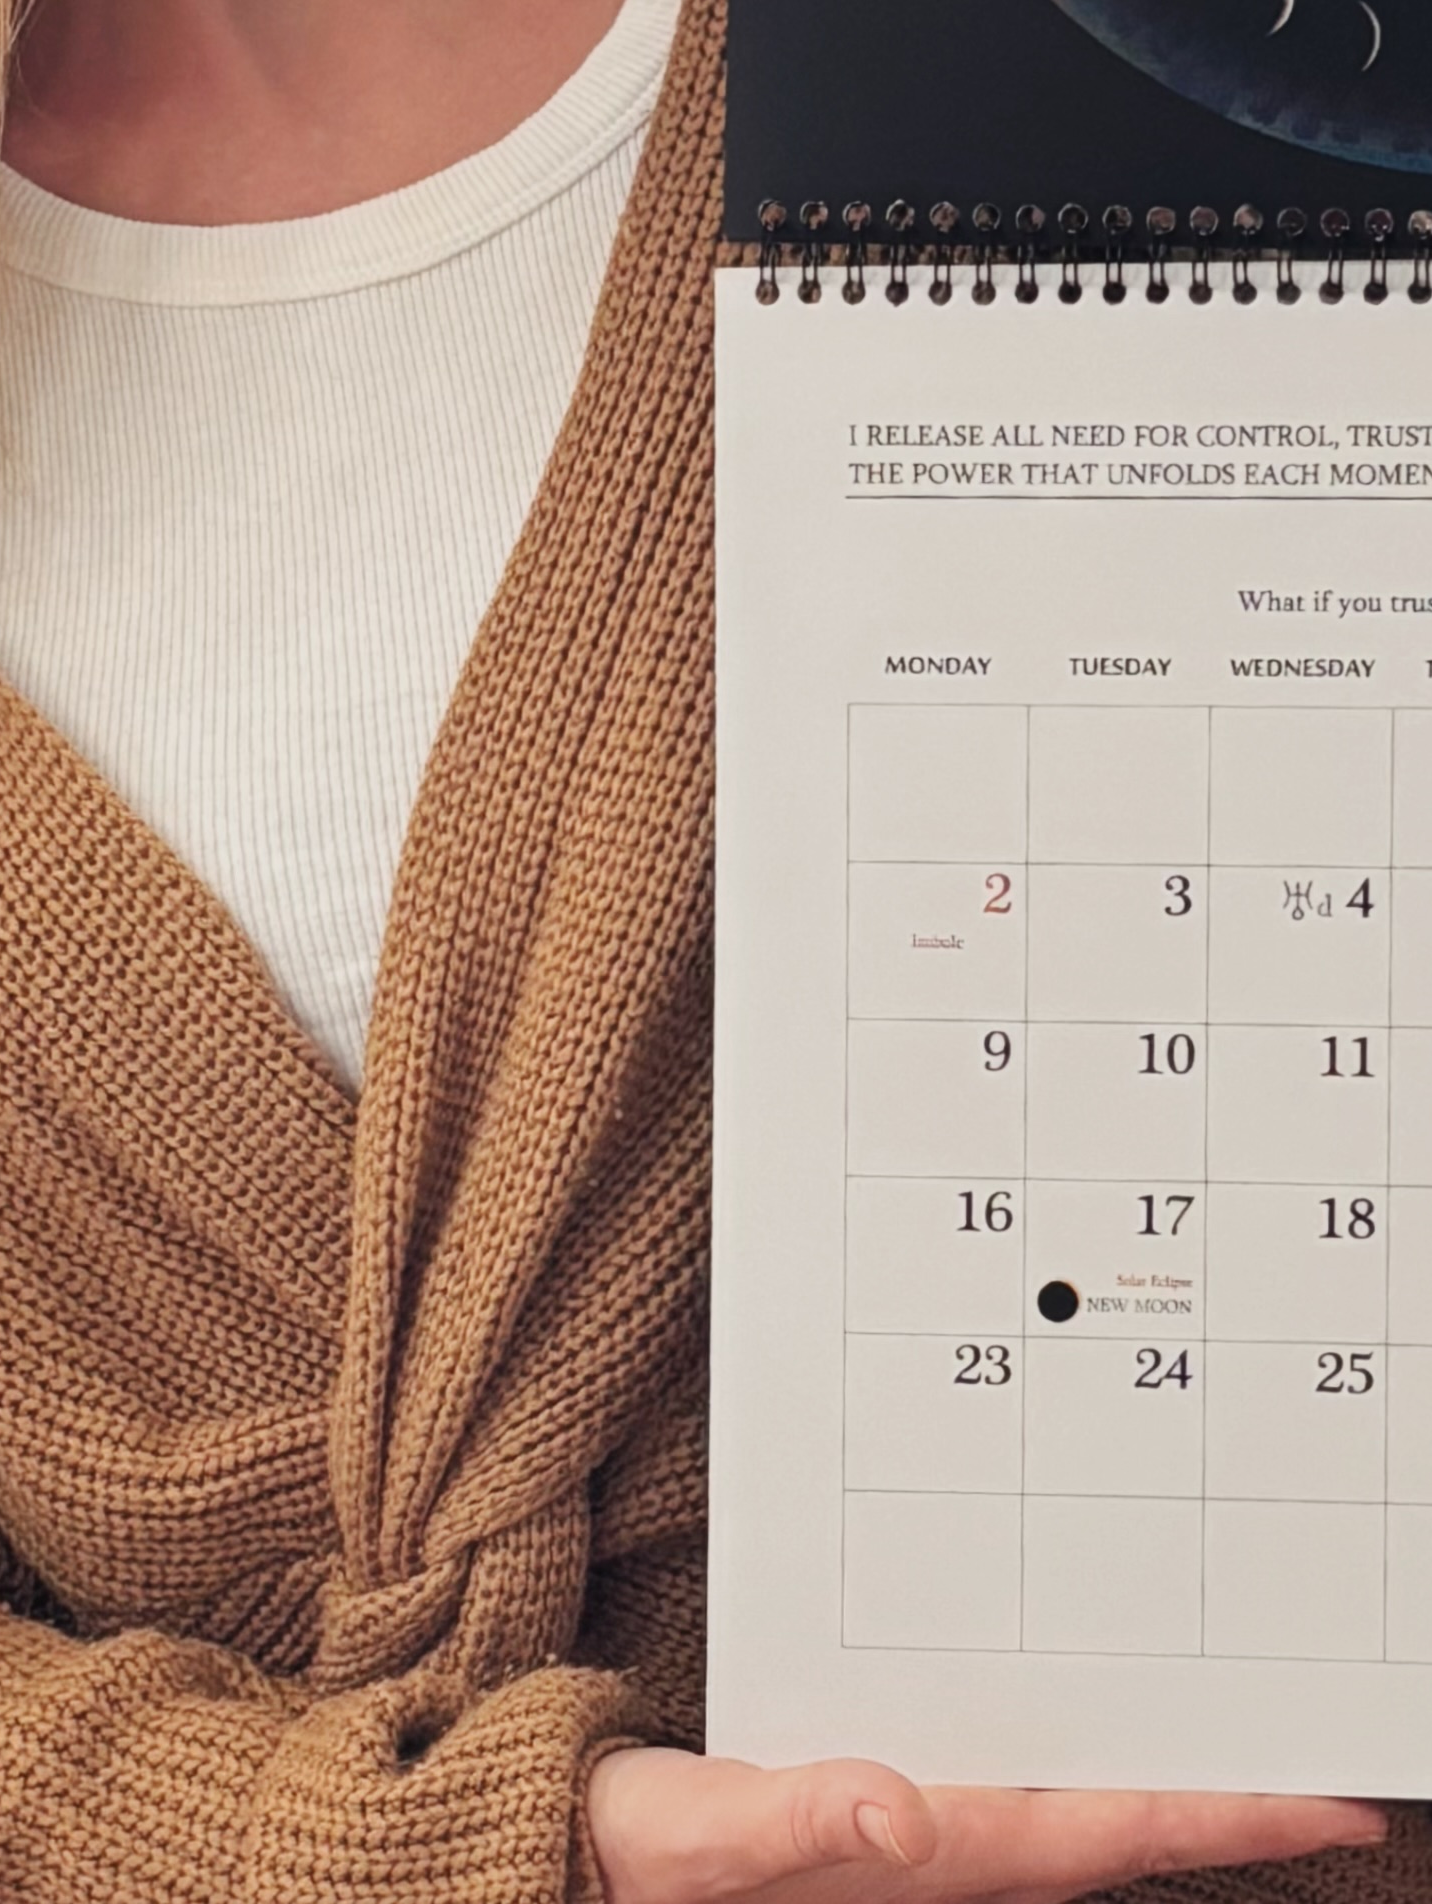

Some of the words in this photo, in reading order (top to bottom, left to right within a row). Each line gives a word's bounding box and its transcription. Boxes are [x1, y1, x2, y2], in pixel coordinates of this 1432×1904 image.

[850, 425, 857, 446] I
[867, 425, 984, 446] RELEASE
[992, 425, 1043, 446] ALL
[1052, 425, 1125, 446] NEED
[1135, 425, 1188, 447] FOR
[1197, 425, 1339, 449] CONTROL,
[849, 463, 903, 484] THE
[913, 463, 1013, 484] POWER
[1021, 463, 1099, 484] THAT
[1108, 463, 1235, 485] UNFOLDS
[1245, 463, 1319, 485] EACH
[1238, 590, 1304, 611] What
[1314, 590, 1333, 612] if
[1339, 597, 1382, 618] you
[885, 656, 991, 675] MONDAY
[1070, 658, 1171, 676] TUESDAY
[1231, 659, 1375, 677] WEDNESDAY
[984, 873, 1011, 913] 2
[1165, 875, 1192, 916] 3
[1346, 878, 1374, 918] 4
[984, 1031, 1011, 1071] 9
[1140, 1034, 1195, 1074] 10
[1322, 1036, 1373, 1077] 11
[958, 1191, 1013, 1232] 16
[1139, 1195, 1194, 1235] 17
[1320, 1198, 1375, 1239] 18
[1087, 1297, 1128, 1312] NEW
[1135, 1299, 1192, 1314] MOON
[954, 1345, 1011, 1385] 23
[1135, 1348, 1192, 1389] 24
[1316, 1352, 1373, 1394] 25
